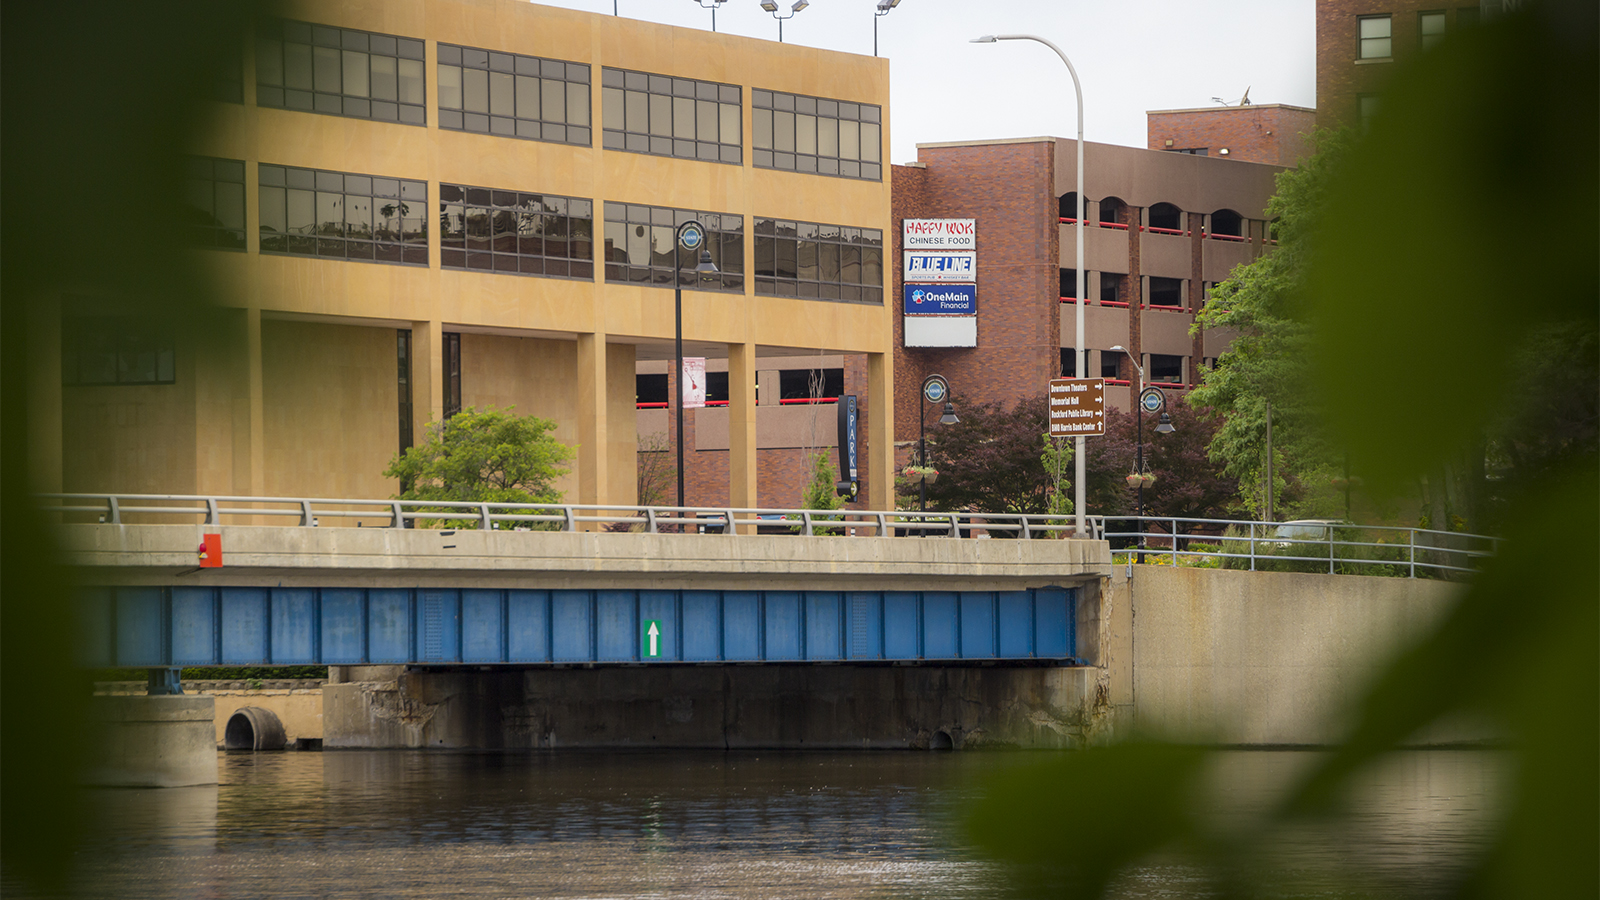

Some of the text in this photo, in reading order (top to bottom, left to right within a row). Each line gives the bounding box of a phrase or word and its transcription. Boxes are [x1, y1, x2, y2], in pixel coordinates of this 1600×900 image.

[906, 222, 973, 234] HAPPY WOK
[909, 256, 971, 271] BLUE LINE
[926, 292, 969, 301] OneMain
[1051, 397, 1070, 405] Memorial
[1052, 410, 1067, 418] Rockford
[1080, 409, 1093, 418] Library
[1073, 423, 1082, 431] Bank
